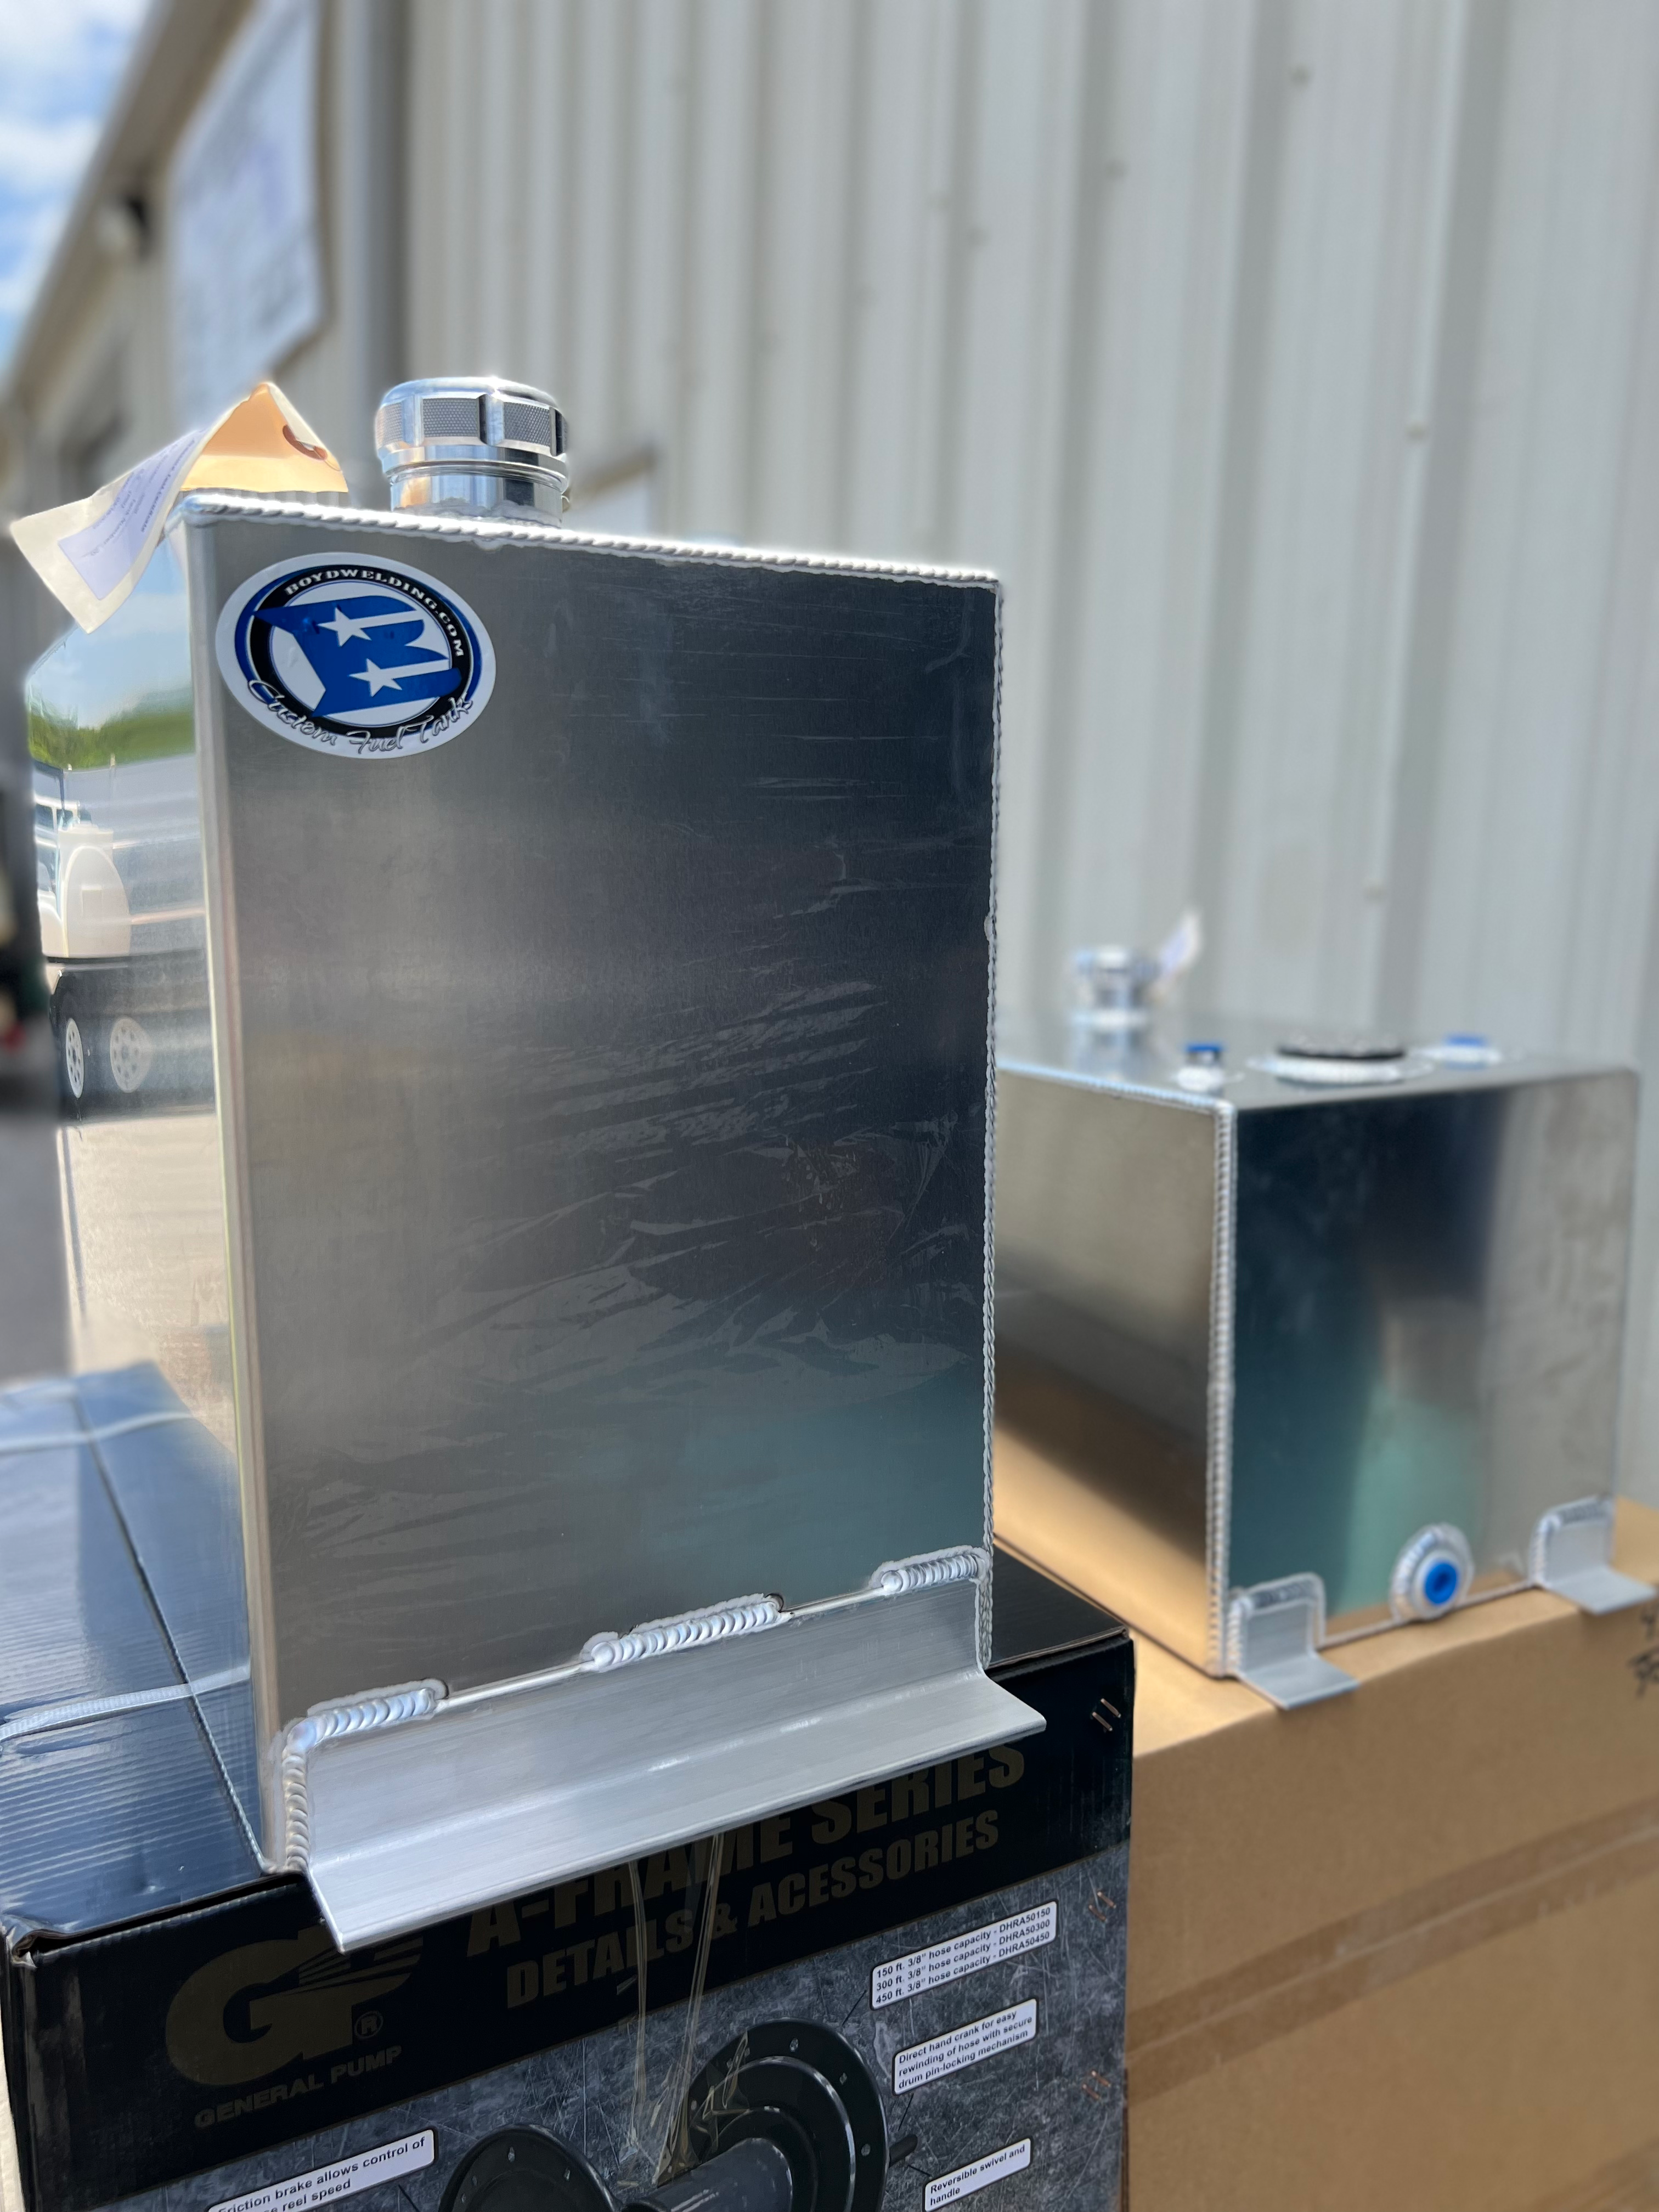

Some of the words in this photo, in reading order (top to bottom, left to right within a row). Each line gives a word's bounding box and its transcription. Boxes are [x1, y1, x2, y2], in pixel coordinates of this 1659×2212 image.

[285, 569, 464, 657] BOYDWELDING.COM
[248, 679, 337, 746] Custom
[346, 730, 403, 755] Fuel
[407, 694, 473, 743] Tanks
[810, 1743, 1025, 1844] SERIES
[507, 1909, 694, 2009] DETAILS
[712, 1902, 738, 1941] &
[747, 1809, 999, 1927] ACESSORIES
[877, 1963, 893, 1978] 150
[929, 1946, 951, 1959] hose
[954, 1929, 991, 1950] capacity
[1000, 1907, 1051, 1932] DHRA50150
[876, 1989, 893, 2004] 450
[928, 1971, 951, 1984] hose
[953, 1955, 990, 1974] capacity
[998, 1932, 1050, 1957] DHRA50450
[877, 1976, 893, 1991] 300
[929, 1958, 951, 1972] hose
[953, 1942, 991, 1962] capacity
[999, 1919, 1051, 1945] DHRA50300
[899, 2049, 927, 2064] Direct
[929, 2037, 952, 2052] hand
[955, 2025, 979, 2041] crank
[981, 2019, 995, 2031] for
[996, 2011, 1017, 2024] easy
[899, 2052, 944, 2076] rewinding
[947, 2046, 957, 2057] of
[958, 2038, 980, 2052] hose
[983, 2029, 1001, 2042] with
[1003, 2017, 1032, 2034] secure
[899, 2073, 923, 2089] drum
[926, 2052, 975, 2079] pin-locking
[978, 2030, 1028, 2056] mechanism
[194, 2073, 325, 2129] GENERAL
[330, 2045, 403, 2084] PUMP
[275, 2180, 313, 2200] brake
[317, 2163, 359, 2184] allows
[363, 2143, 408, 2168] control
[413, 2136, 426, 2149] of
[282, 2194, 307, 2212] reel
[312, 2178, 351, 2202] speed
[930, 2168, 977, 2194] Reversible
[980, 2153, 1007, 2171] swivel
[1009, 2143, 1025, 2159] and
[930, 2187, 961, 2206] handle
